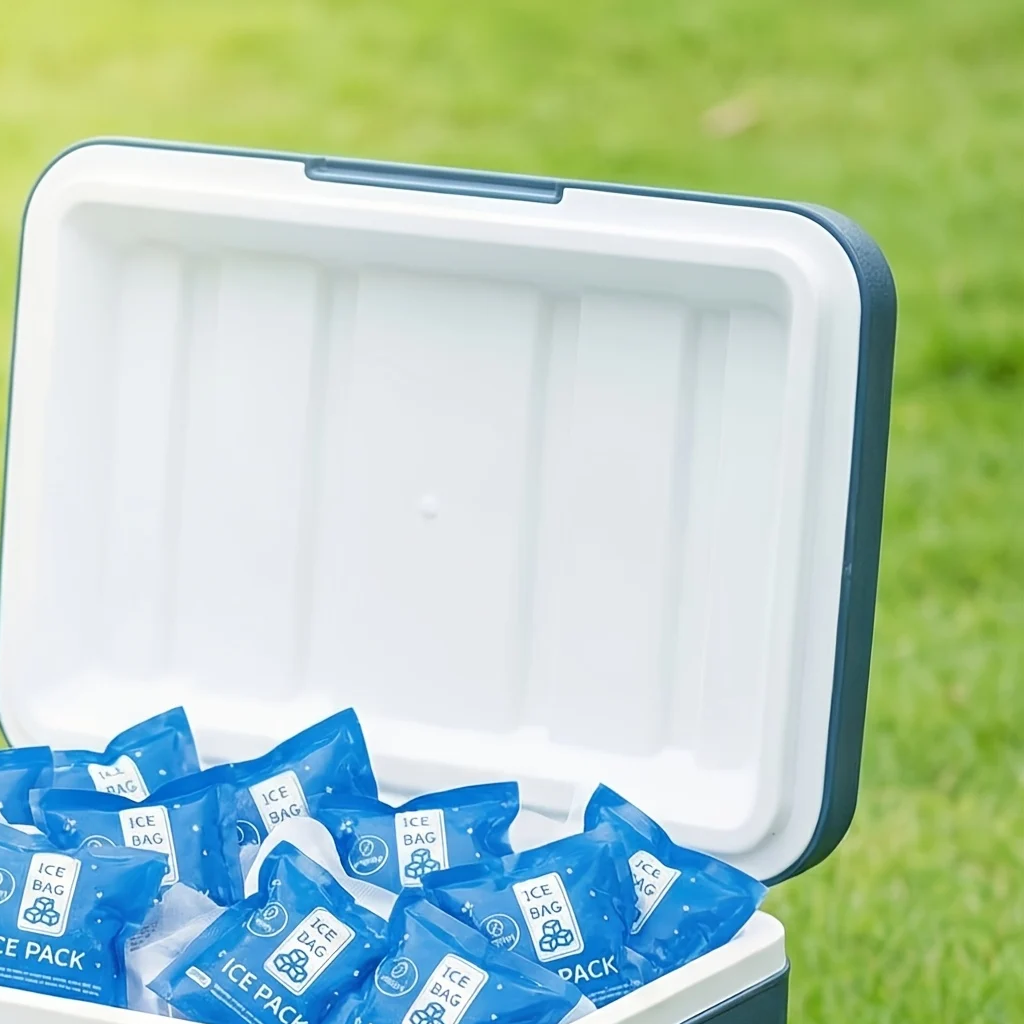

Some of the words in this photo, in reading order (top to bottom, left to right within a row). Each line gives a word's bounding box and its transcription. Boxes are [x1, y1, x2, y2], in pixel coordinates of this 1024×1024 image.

[262, 786, 289, 805] ICE
[129, 815, 156, 829] ICE
[268, 803, 301, 824] BAG
[403, 816, 429, 828] ICE
[132, 833, 164, 847] BAG
[403, 832, 437, 846] BAG
[38, 863, 66, 878] ICE
[635, 859, 661, 879] ICE
[32, 879, 65, 896] BAG
[521, 884, 553, 902] ICE
[633, 874, 657, 896] AG
[529, 901, 562, 920] BAG
[310, 917, 338, 943] ICE
[297, 931, 327, 958] BAG
[24, 941, 86, 971] PACK
[221, 957, 258, 992] ICE
[441, 966, 471, 989] ICE
[558, 955, 619, 984] PACK
[430, 982, 462, 1008] BAG
